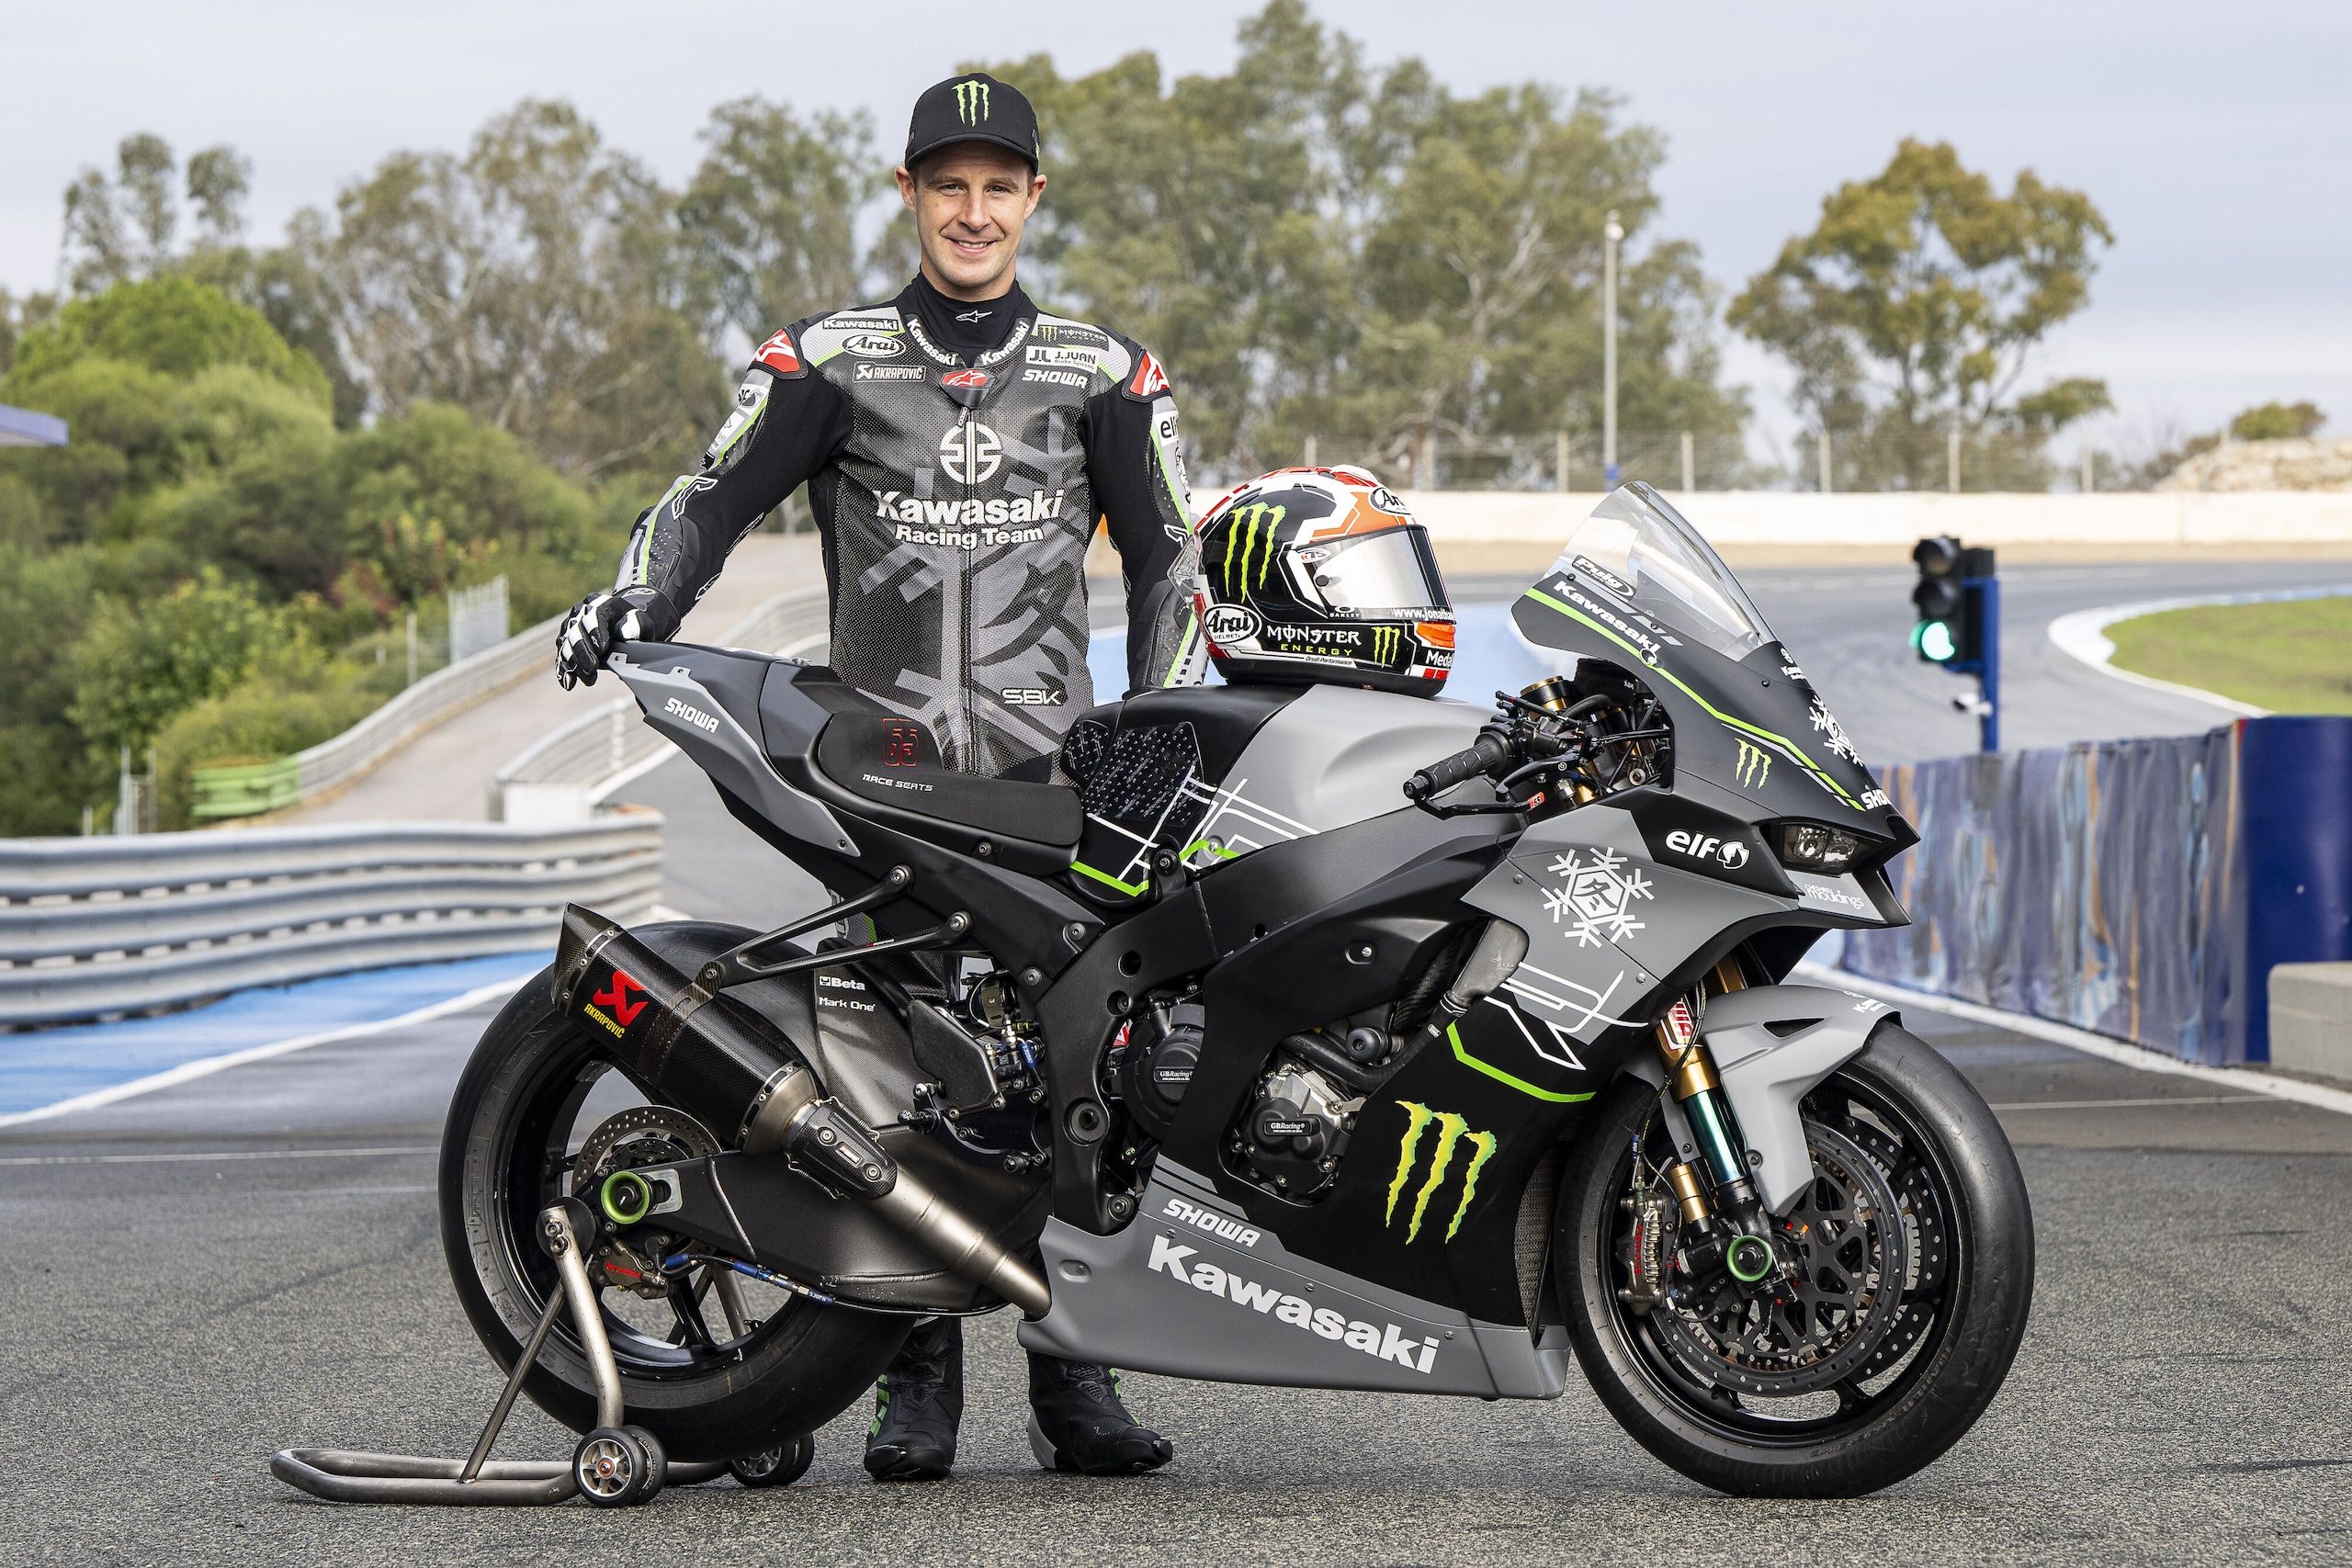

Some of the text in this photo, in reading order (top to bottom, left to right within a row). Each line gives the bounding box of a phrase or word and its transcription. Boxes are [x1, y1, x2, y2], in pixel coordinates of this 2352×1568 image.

[823, 319, 899, 331] Kawasaki
[847, 336, 897, 350] Arai
[907, 318, 956, 366] Kawasaki
[980, 320, 1030, 366] Kawasaki
[1054, 351, 1096, 365] J.JUAN
[1022, 368, 1088, 389] SHOWA
[872, 489, 1065, 525] Kawasaki
[895, 524, 1045, 551] Racing Team
[1575, 557, 1624, 590] Puig
[1205, 610, 1251, 633] Arai
[1553, 581, 1661, 654] Kawasaki
[1266, 624, 1363, 647] MONSTER
[1280, 643, 1353, 657] ENERGY
[1001, 688, 1062, 706] SBK
[663, 696, 720, 734] SHOWA
[862, 773, 934, 792] RACE SEATS
[1860, 789, 1892, 810] SHO
[1665, 829, 1720, 860] elf
[831, 976, 865, 991] Beta
[819, 996, 875, 1012] Mark One
[1162, 1198, 1261, 1248] SHOWA
[1147, 1234, 1441, 1375] Kawasaki
